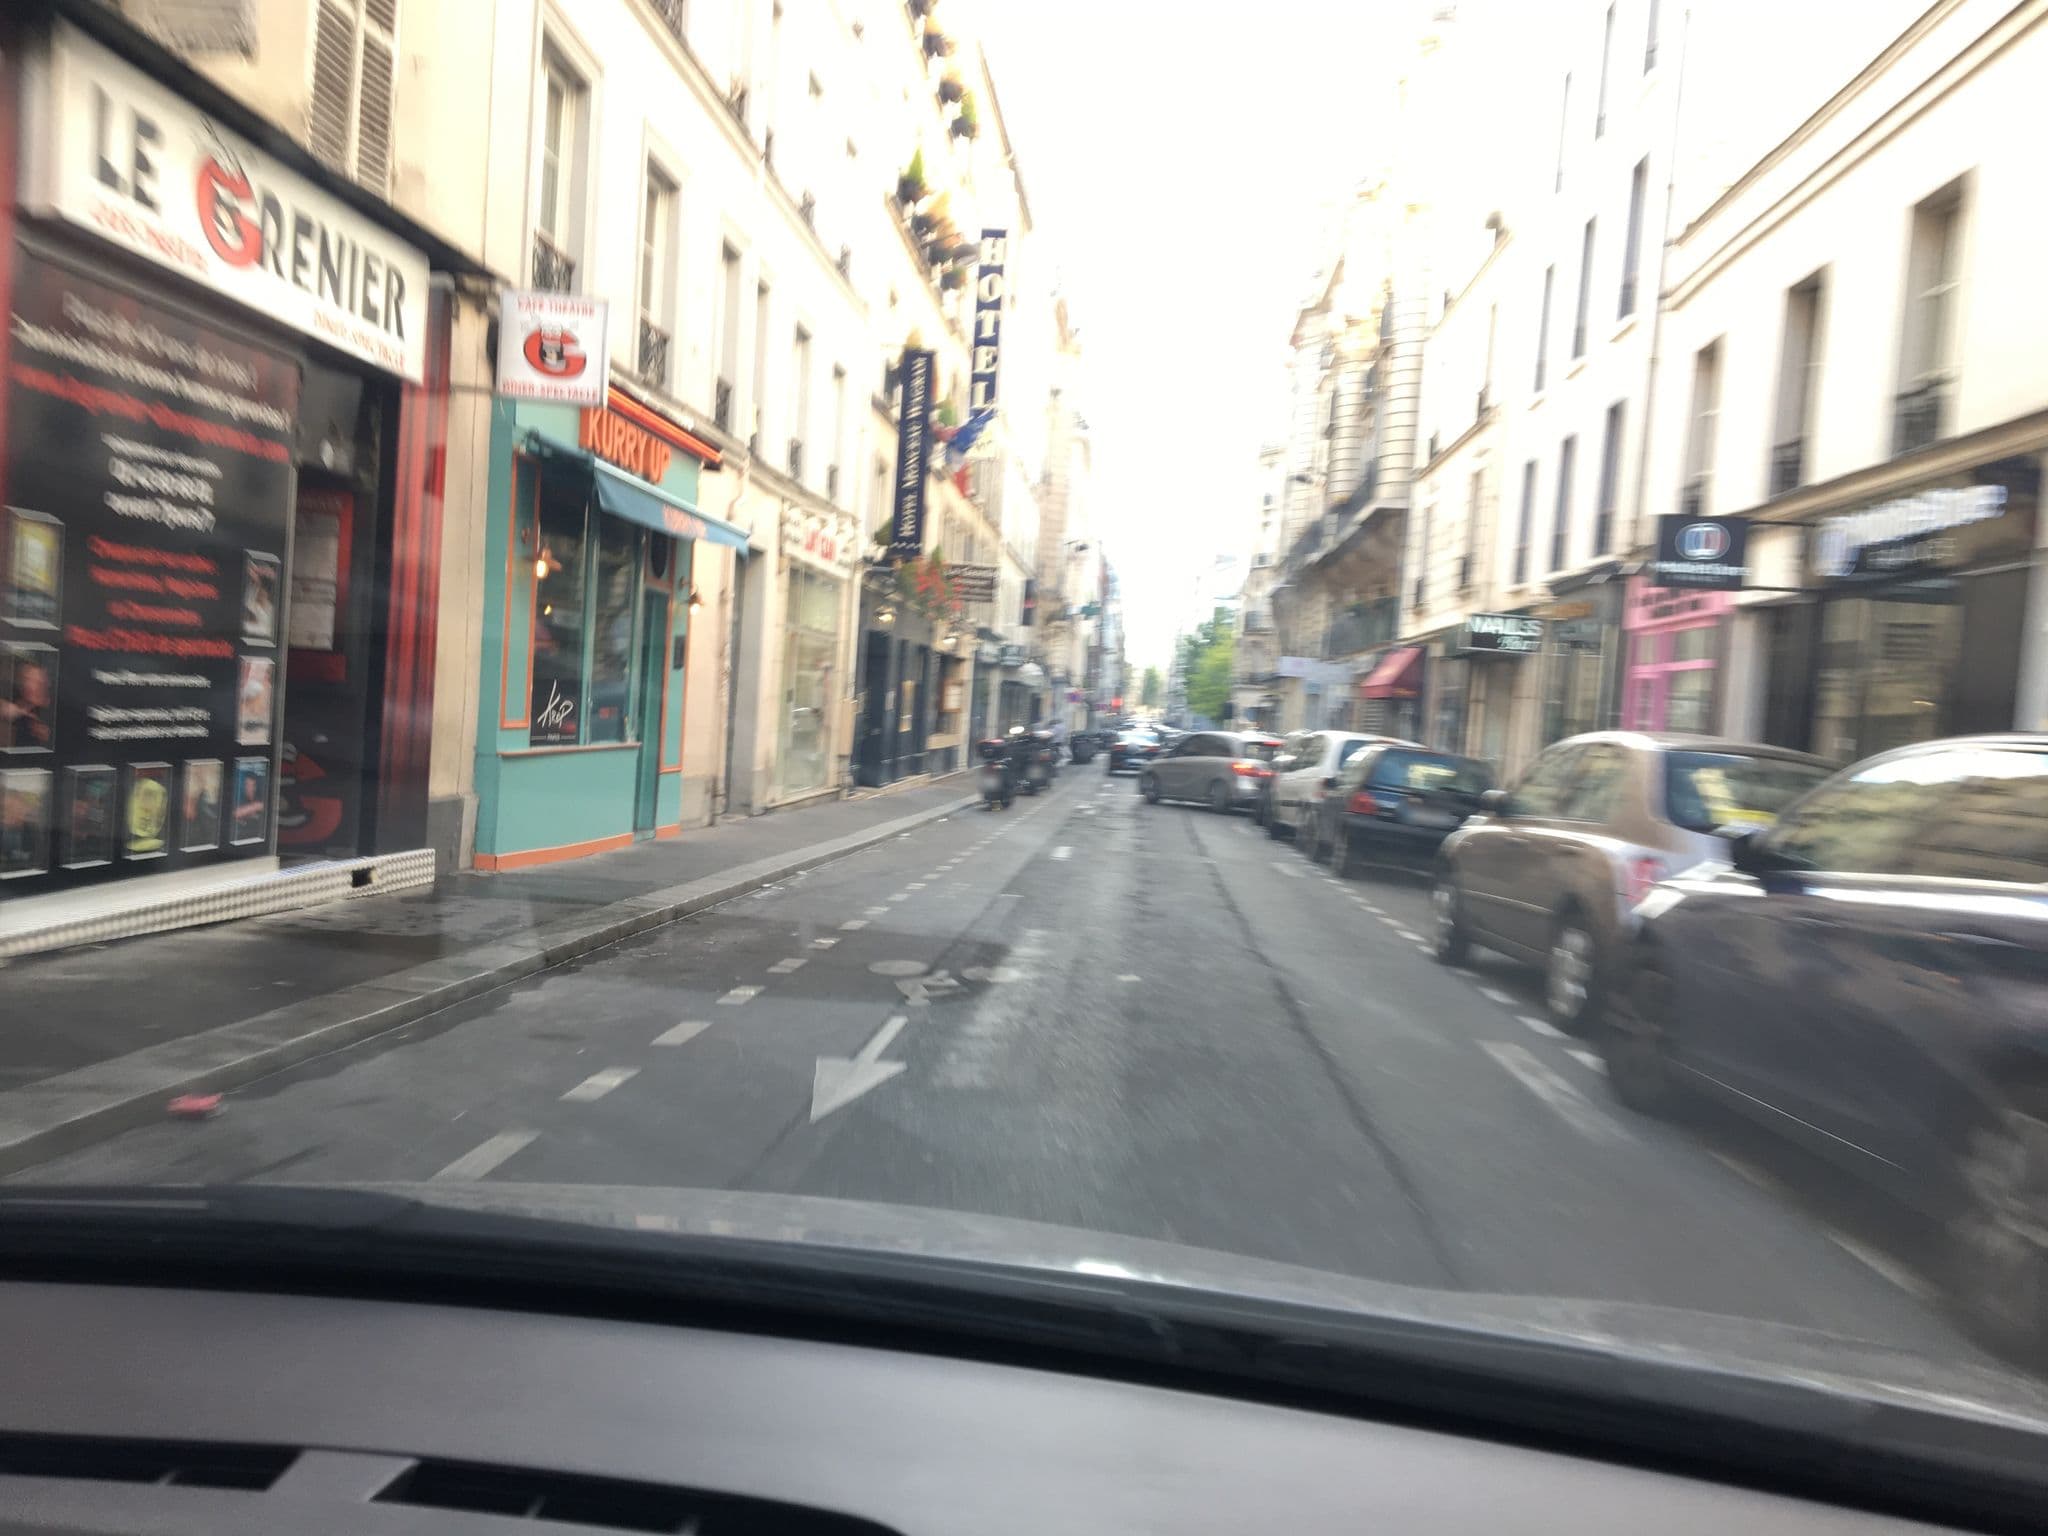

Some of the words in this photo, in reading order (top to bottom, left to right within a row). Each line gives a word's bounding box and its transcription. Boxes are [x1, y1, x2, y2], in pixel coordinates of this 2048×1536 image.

[91, 82, 162, 214] LE
[197, 153, 406, 342] GRENIER
[970, 236, 1007, 409] HOTEL
[588, 408, 648, 474] KURRY
[649, 437, 673, 485] UP
